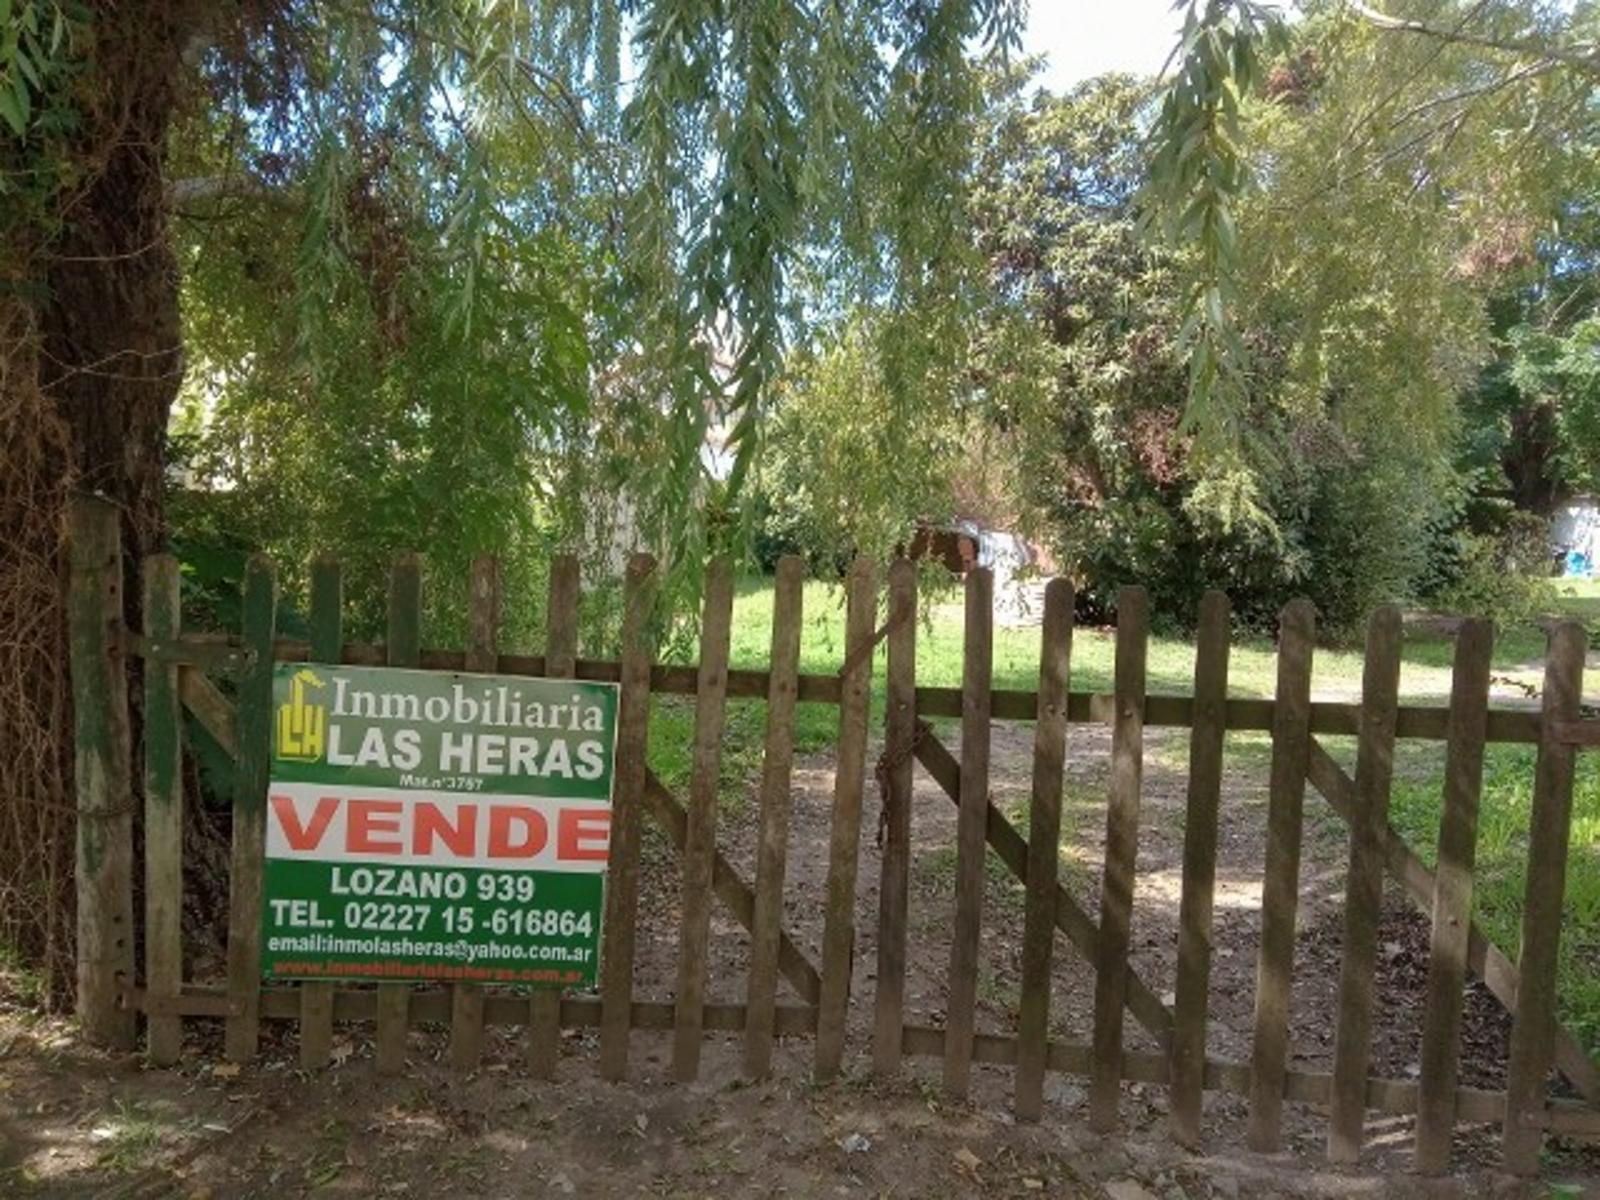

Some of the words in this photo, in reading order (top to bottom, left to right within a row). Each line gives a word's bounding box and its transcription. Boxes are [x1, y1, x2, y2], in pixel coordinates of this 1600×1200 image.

[331, 676, 605, 732] Inmobiliaria
[326, 725, 421, 771] LAS
[438, 731, 605, 780] HERAS
[270, 796, 612, 861] VENDE
[330, 867, 467, 900] LOZANO
[477, 874, 535, 903] 939
[270, 899, 335, 928] TEL.
[344, 903, 431, 931] 02227
[441, 906, 474, 933] 15
